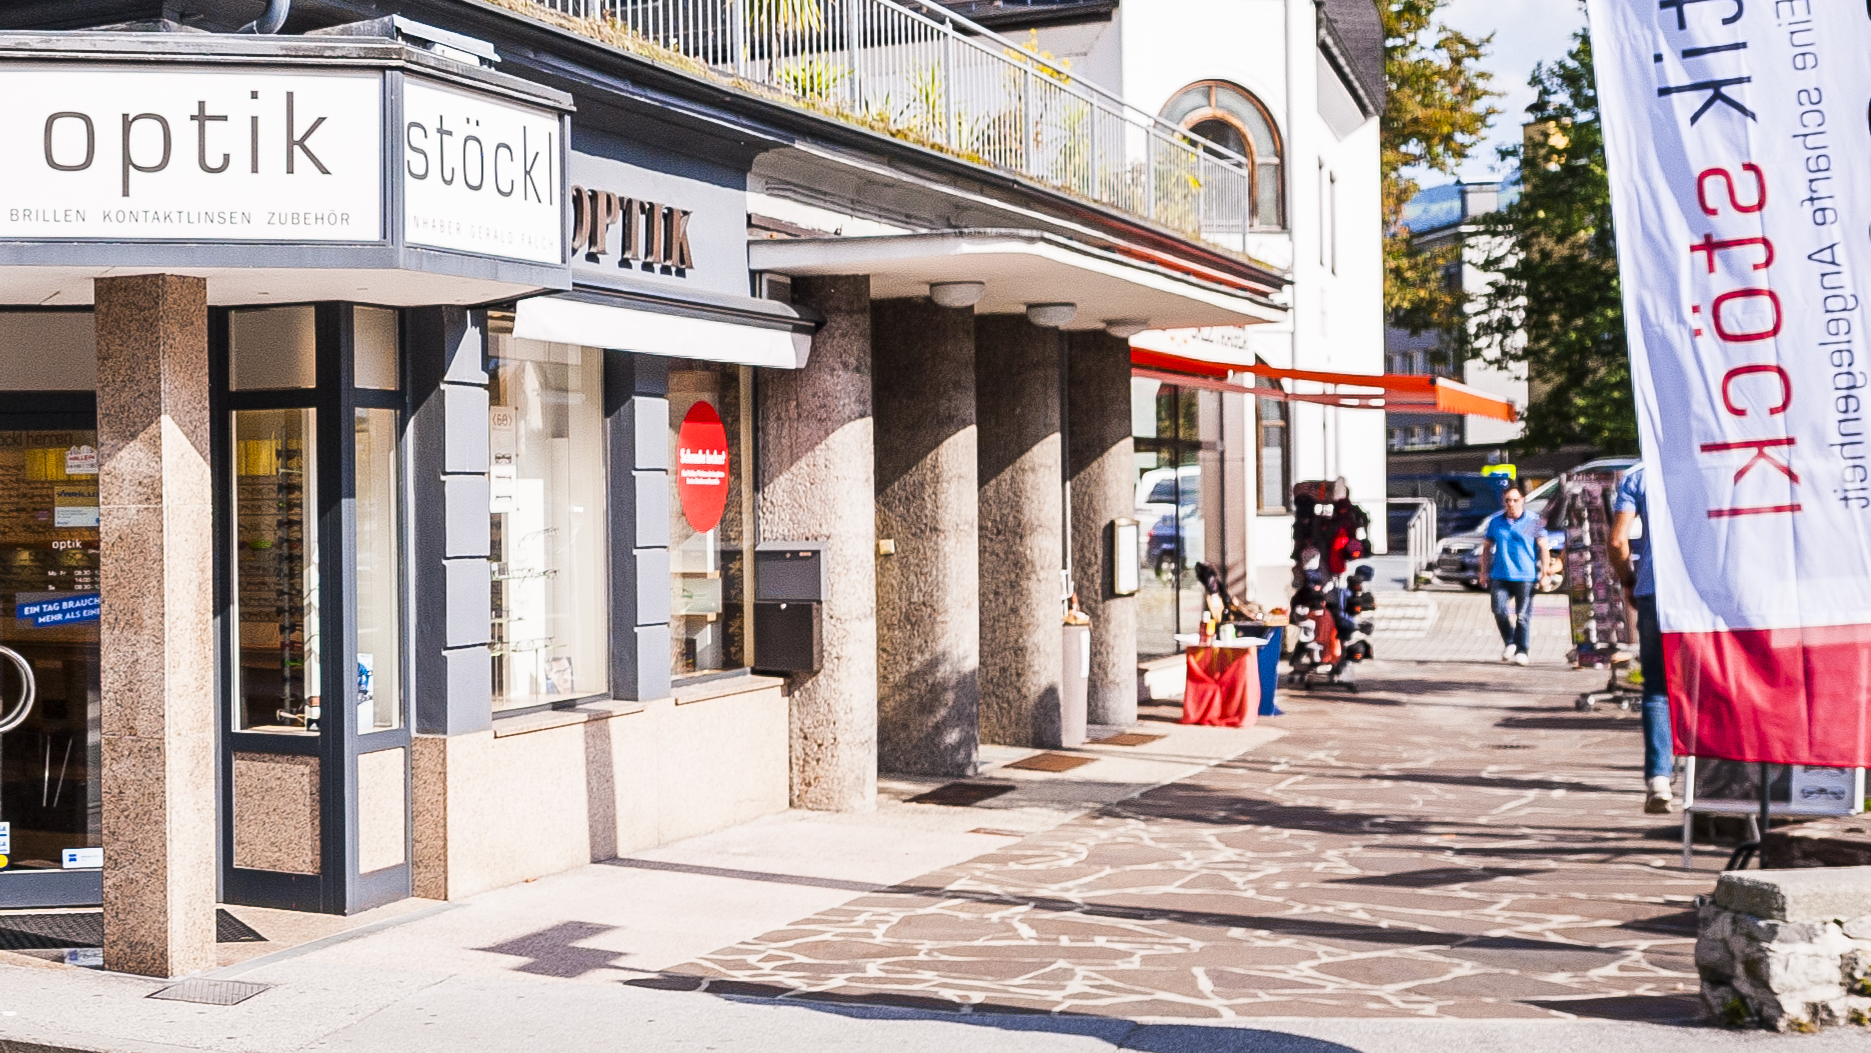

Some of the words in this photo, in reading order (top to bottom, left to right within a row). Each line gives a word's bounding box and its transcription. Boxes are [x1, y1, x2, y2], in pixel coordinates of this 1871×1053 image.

[43, 90, 333, 197] optik
[406, 114, 553, 206] stöckl
[9, 208, 86, 223] BRILLEN
[102, 209, 252, 225] KONTAKTLINSEN
[266, 208, 351, 226] ZUBEHÖR
[51, 538, 83, 552] optik
[23, 604, 41, 616] EIN
[41, 602, 61, 613] TAG
[37, 613, 63, 624] MEHR
[64, 610, 81, 620] ALS
